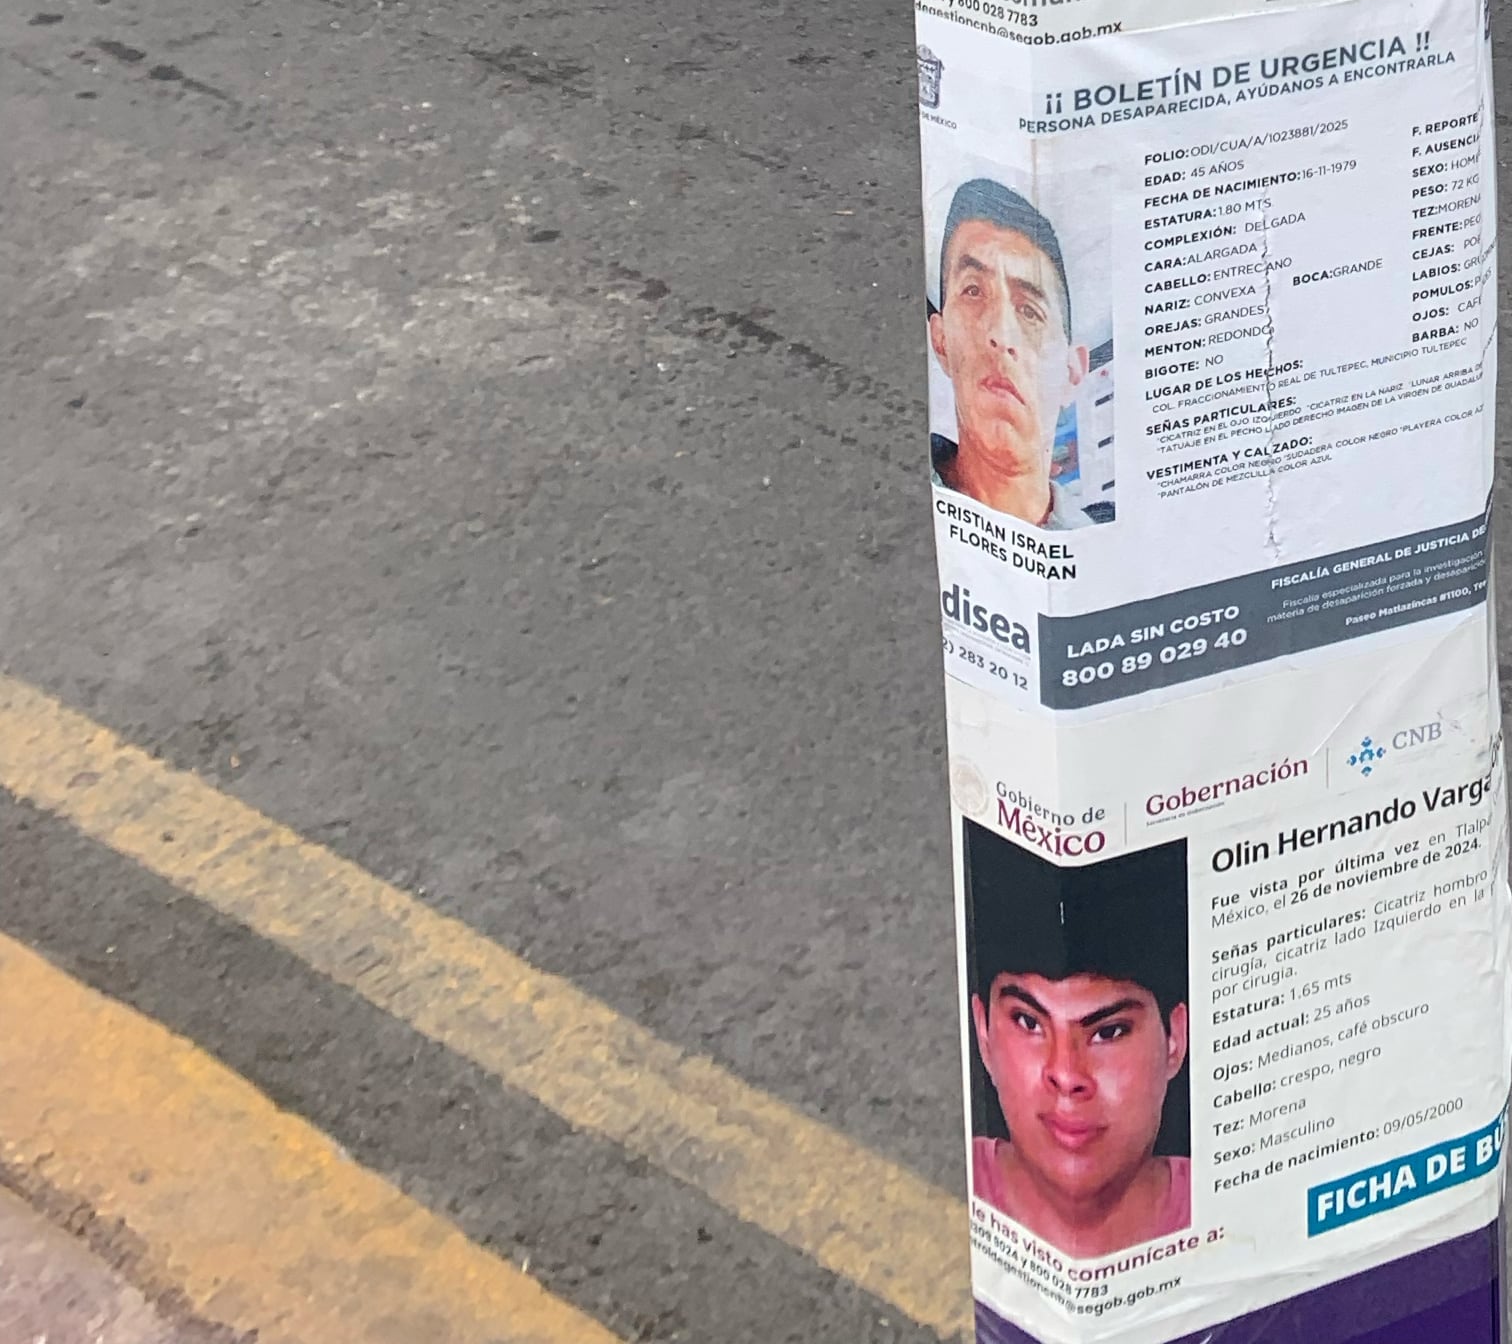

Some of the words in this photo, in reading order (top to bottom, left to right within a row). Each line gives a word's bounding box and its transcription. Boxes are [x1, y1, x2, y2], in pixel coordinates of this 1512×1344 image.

[1019, 114, 1096, 135] PERSONA
[1101, 92, 1232, 125] DESAPARECIDA,
[1235, 73, 1324, 102] AYÚDANOS
[1329, 73, 1341, 86] A
[1344, 52, 1456, 84] ENCONTRARLA
[1073, 65, 1202, 111] BOLETÍN
[1213, 63, 1251, 87] DE
[1260, 35, 1406, 78] URGENCIA
[1425, 112, 1479, 134] REPORTE
[1145, 171, 1186, 187] EDAD:
[1190, 166, 1205, 178] 45
[1210, 159, 1245, 176] AÑOS
[1145, 225, 1236, 251] COMPLEXIÓN:
[1245, 212, 1306, 233] DELGADA
[1145, 298, 1190, 315] NARIZ:
[1194, 286, 1256, 306] CONVEXA
[1412, 325, 1459, 343] BARBA:
[1464, 318, 1479, 332] NO
[1145, 361, 1199, 380] BIGOTE:
[1205, 355, 1224, 367] NO
[936, 500, 1005, 541] CRISTIAN
[1012, 531, 1074, 559] ISRAEL
[950, 525, 1006, 562] FLORES
[1013, 552, 1076, 580] DURAN
[1271, 567, 1329, 590] FISCALÍA
[1333, 552, 1392, 574] GENERAL
[1394, 547, 1412, 559] DE
[1414, 533, 1470, 554] JUSTICIA
[1061, 661, 1115, 688] 800
[1121, 648, 1151, 674] 89
[1159, 637, 1209, 666] 029
[1215, 626, 1249, 650] 40
[1066, 632, 1126, 659] LADA
[1130, 622, 1167, 646] SIN
[1169, 604, 1240, 636] COSTO
[959, 646, 985, 669] 283
[989, 662, 1008, 680] 20
[1013, 673, 1028, 690] 12
[1392, 721, 1443, 751] CNB
[995, 779, 1076, 826] Gobierno
[1082, 805, 1106, 824] de
[1145, 755, 1309, 817] Gobernación
[997, 798, 1105, 857] México
[1211, 841, 1270, 873] Olin
[1278, 798, 1416, 856] Hernando
[1290, 890, 1309, 906] 26
[1313, 882, 1332, 899] de
[1336, 858, 1419, 893] noviembre
[1422, 848, 1441, 865] de
[1445, 837, 1482, 859] 2024.
[1212, 995, 1285, 1025] Estatura:
[1289, 980, 1320, 1002] 1.65
[1324, 972, 1352, 990] mts
[1213, 1118, 1245, 1137] Tez:
[1249, 1097, 1306, 1127] Morena
[1317, 1165, 1416, 1222] FICHA
[1426, 1147, 1466, 1184] DE
[1022, 1236, 1062, 1273] visto
[1068, 1236, 1199, 1283] comunícate
[1206, 1225, 1225, 1243] a:
